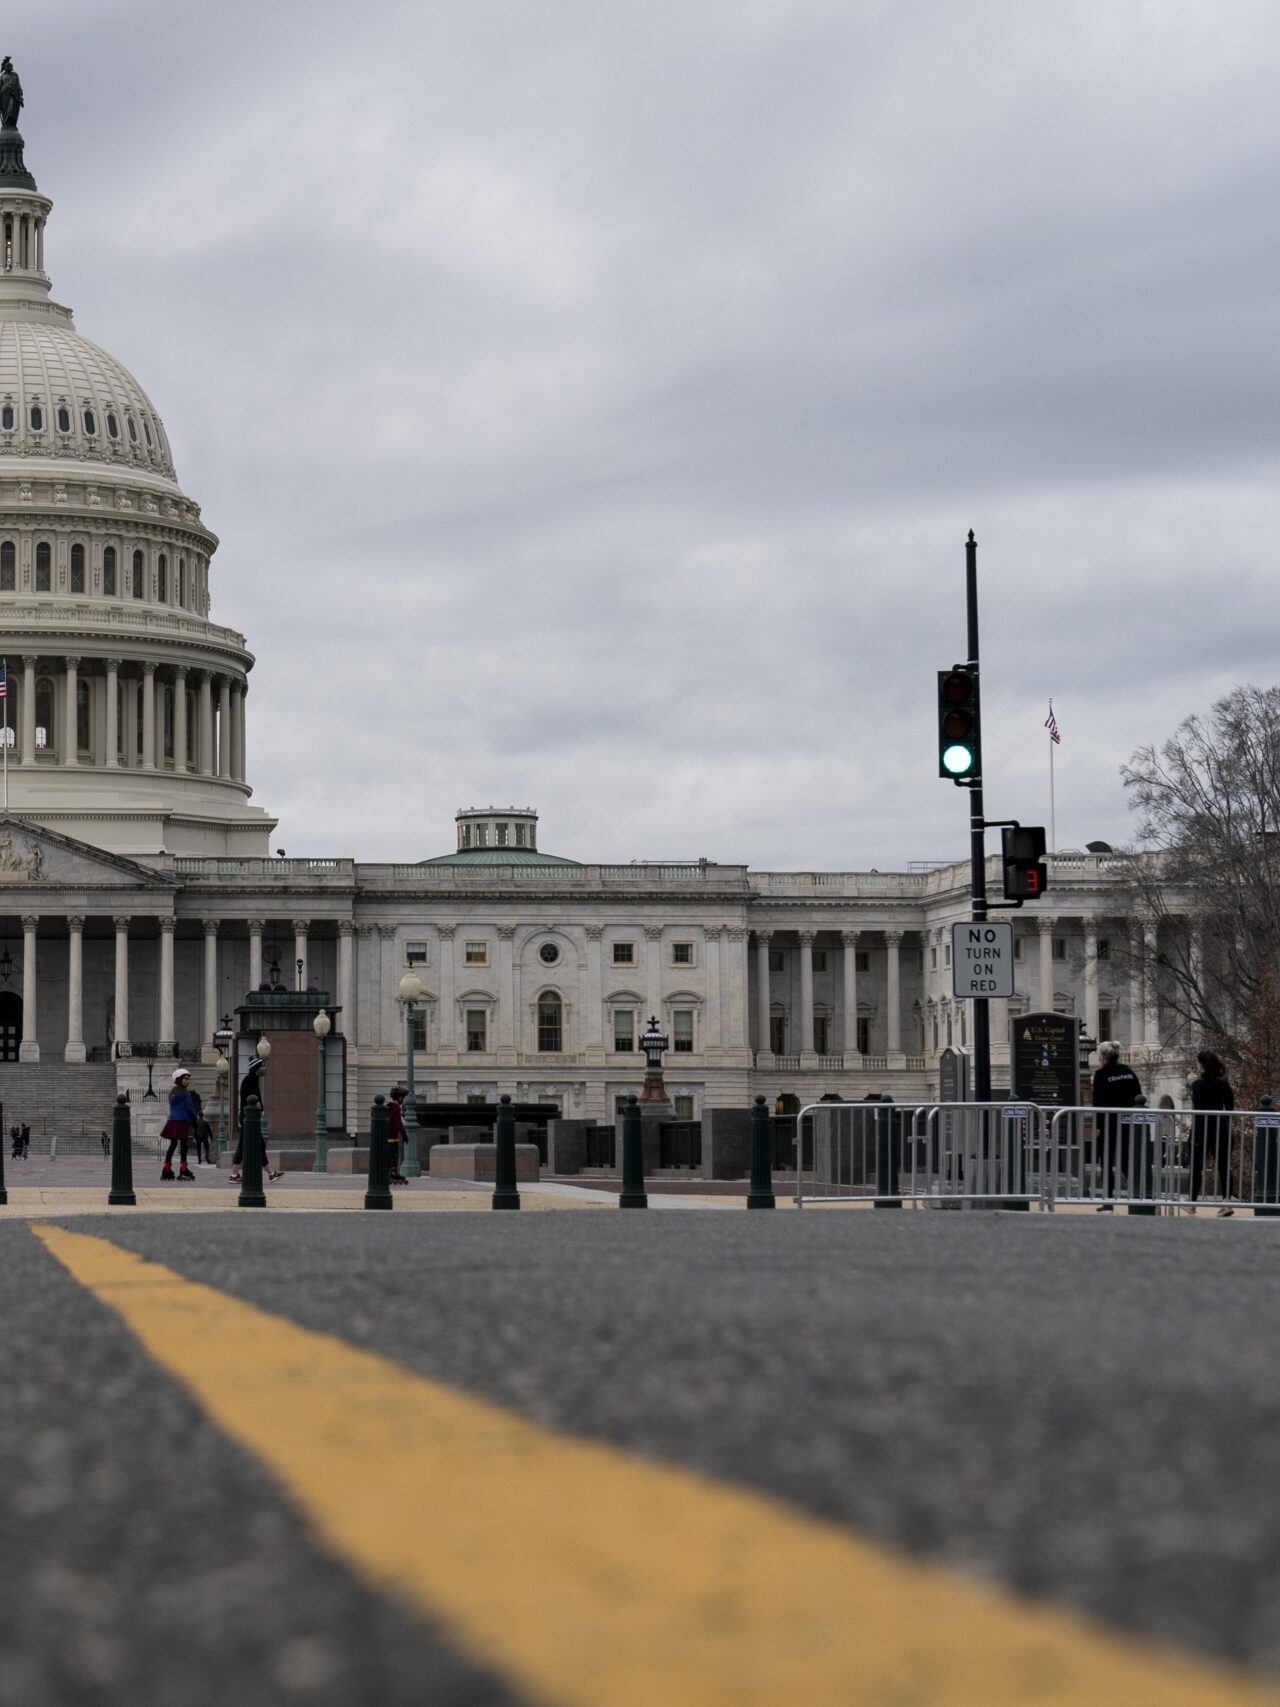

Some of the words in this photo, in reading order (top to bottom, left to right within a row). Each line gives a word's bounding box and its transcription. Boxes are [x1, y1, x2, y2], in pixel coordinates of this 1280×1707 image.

[969, 929, 996, 943] NO
[965, 947, 1001, 959] TURN
[973, 963, 993, 975] ON
[970, 979, 997, 991] RED
[1044, 1026, 1066, 1035] Capitol
